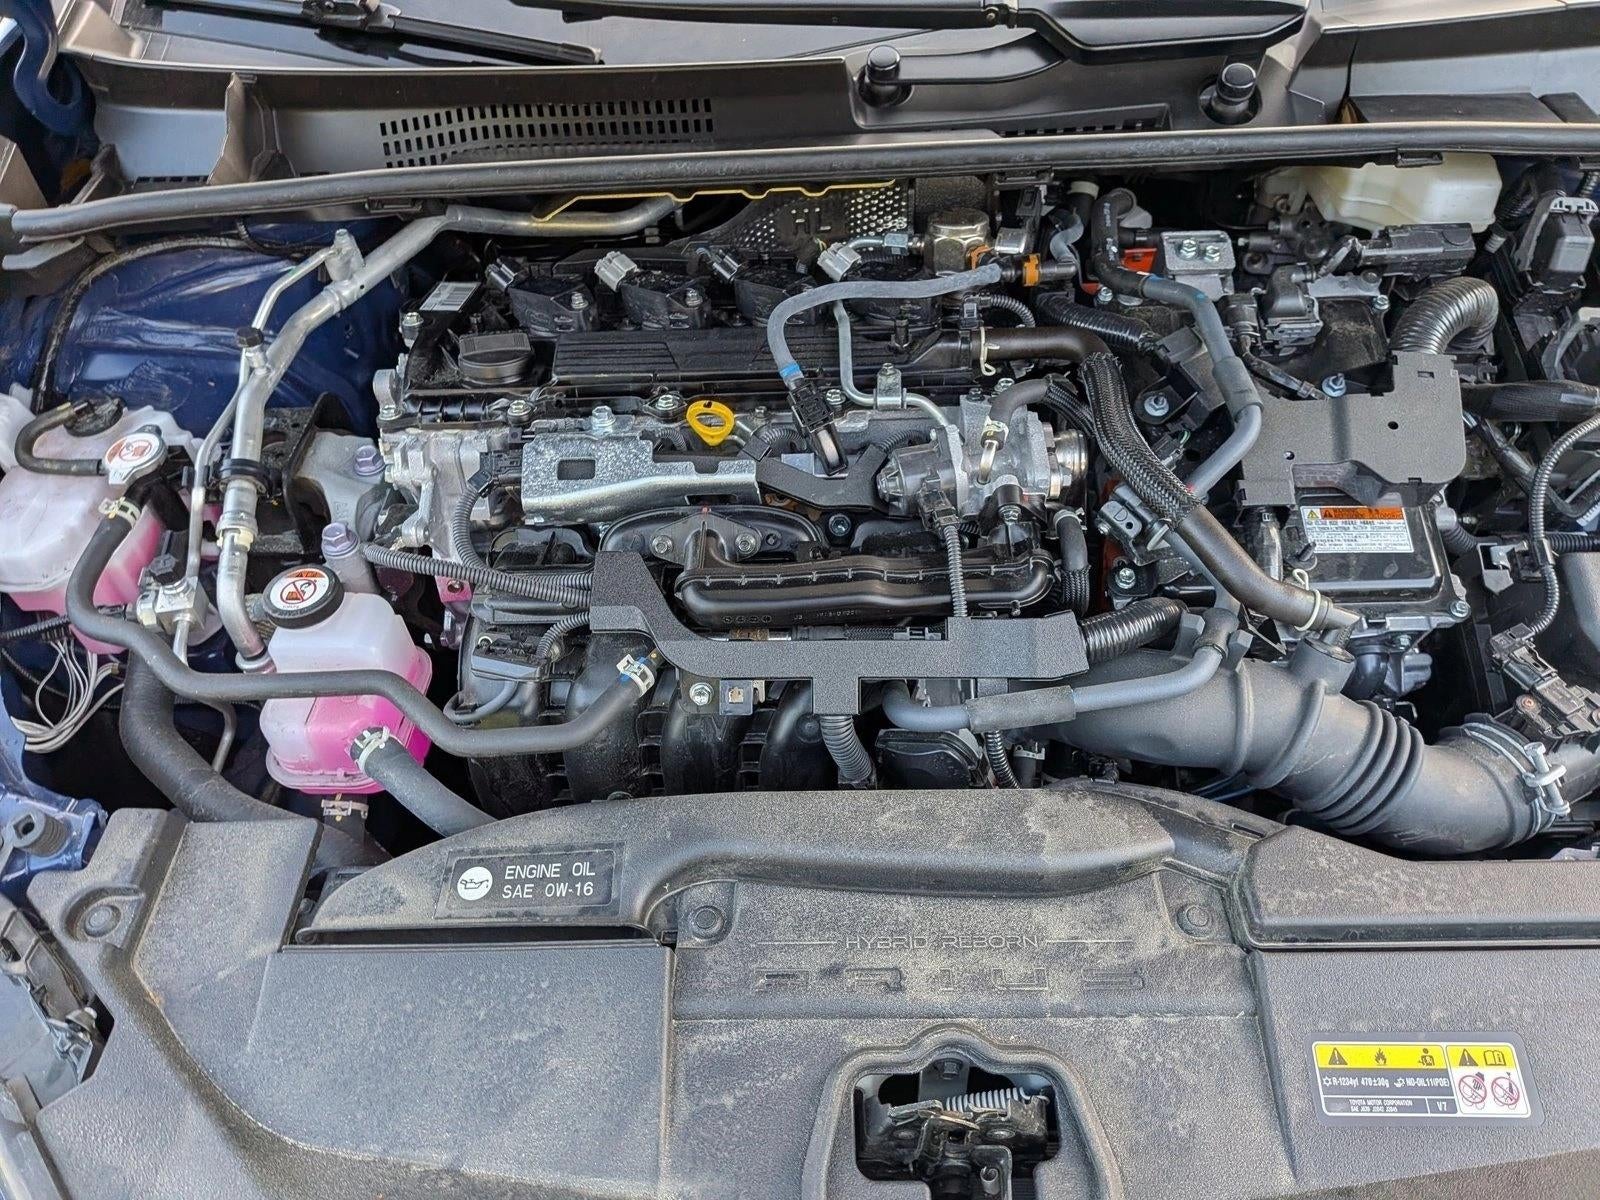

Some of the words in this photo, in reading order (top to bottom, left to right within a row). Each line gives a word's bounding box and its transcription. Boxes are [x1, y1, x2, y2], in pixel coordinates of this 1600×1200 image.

[505, 863, 562, 880] ENGINE
[572, 861, 596, 877] OIL
[502, 884, 535, 899] SAE
[545, 881, 594, 898] 0W-16
[845, 936, 928, 949] HYBRID
[941, 935, 1039, 948] REBORN
[1436, 1101, 1447, 1111] V7
